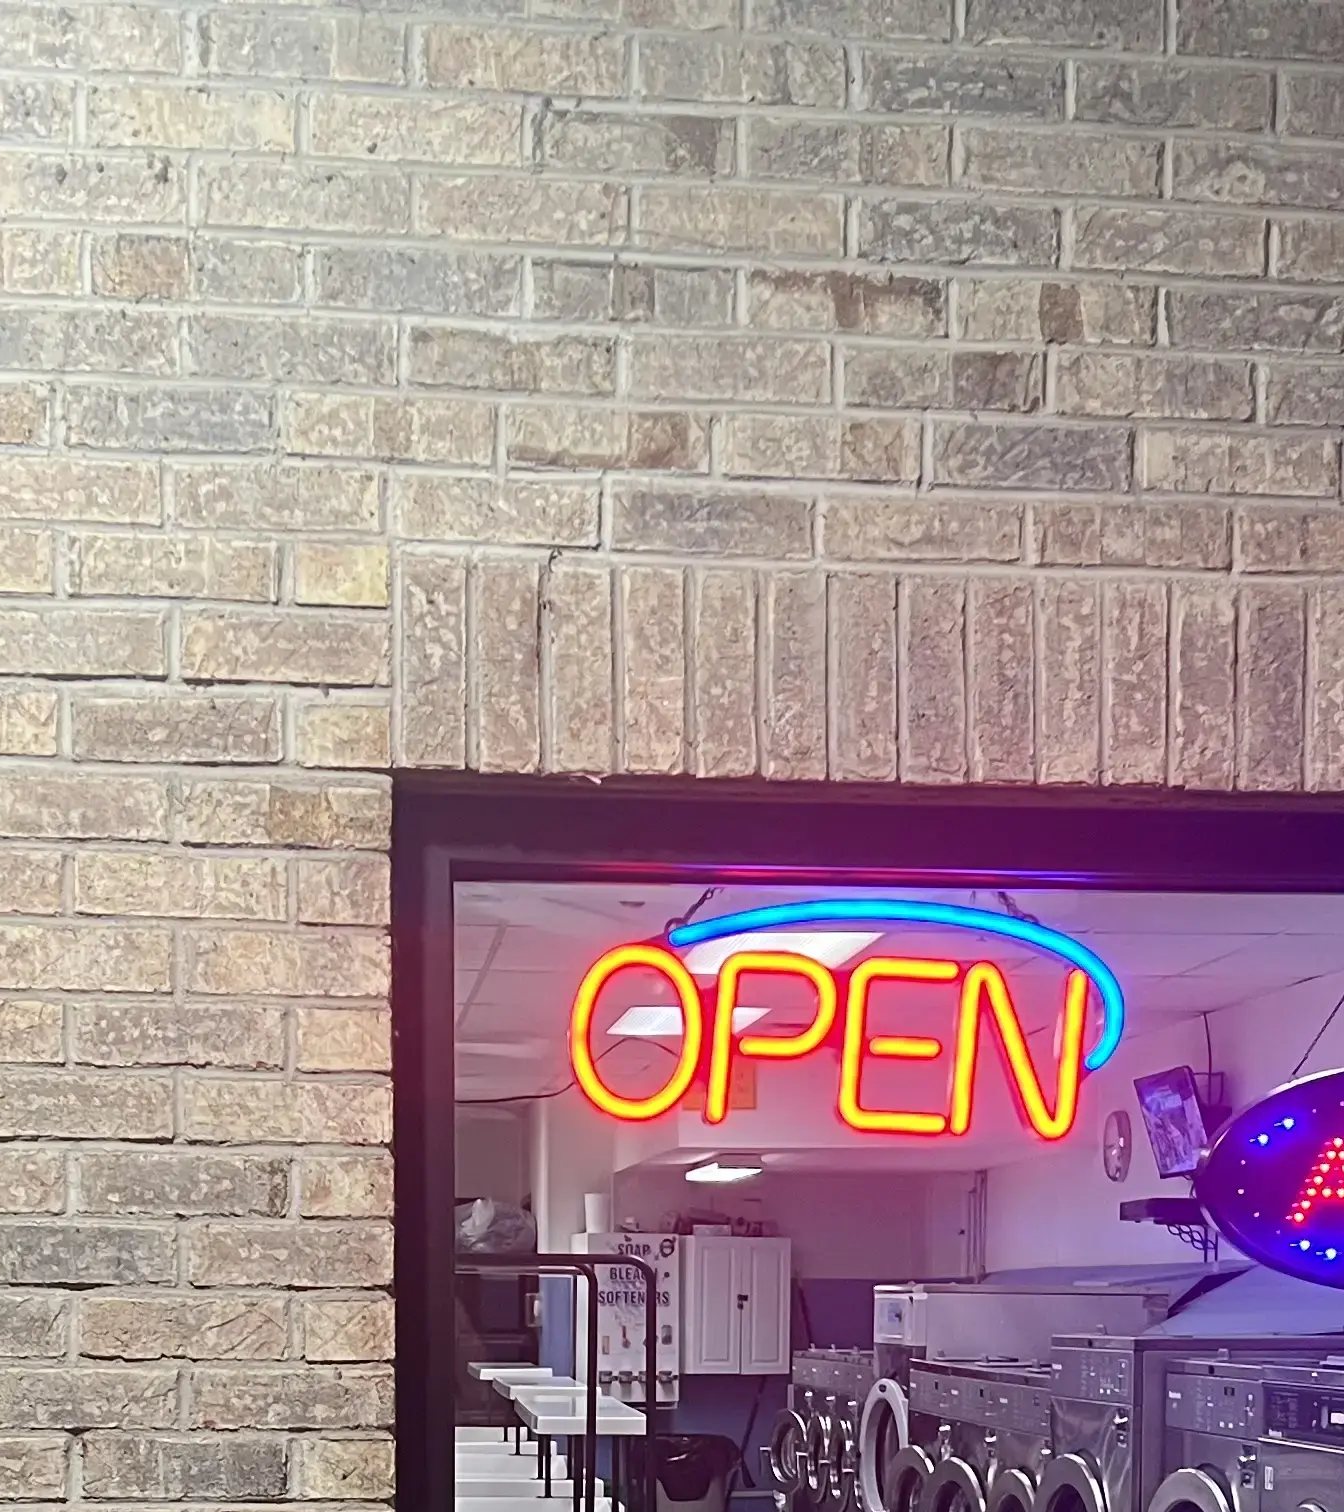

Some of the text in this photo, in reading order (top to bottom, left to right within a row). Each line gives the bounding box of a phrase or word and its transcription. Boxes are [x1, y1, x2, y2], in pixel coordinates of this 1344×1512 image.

[570, 941, 1088, 1139] OPEN
[609, 1267, 658, 1280] BLEA
[598, 1290, 670, 1304] SOFTENRS
